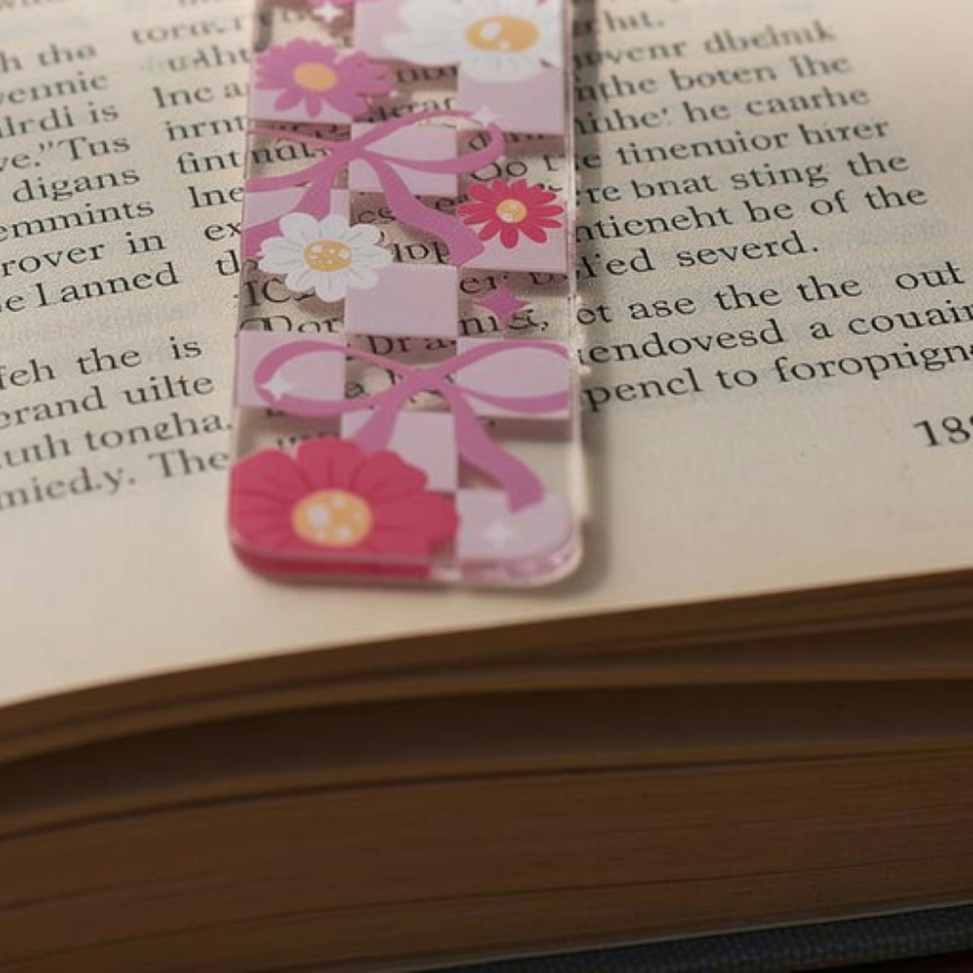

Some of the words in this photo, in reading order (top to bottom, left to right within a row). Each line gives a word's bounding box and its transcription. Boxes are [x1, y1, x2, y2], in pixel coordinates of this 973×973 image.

[88, 100, 119, 124] is
[730, 162, 829, 188] sting
[847, 151, 909, 177] the
[810, 189, 849, 215] of
[864, 185, 928, 210] the
[126, 231, 166, 255] in
[628, 297, 697, 321] ase
[714, 284, 783, 311] the
[796, 275, 862, 302] the
[895, 260, 966, 290] out
[810, 322, 834, 340] a
[77, 347, 142, 376] the
[169, 335, 202, 360] is
[714, 369, 758, 390] to
[148, 448, 229, 479] The
